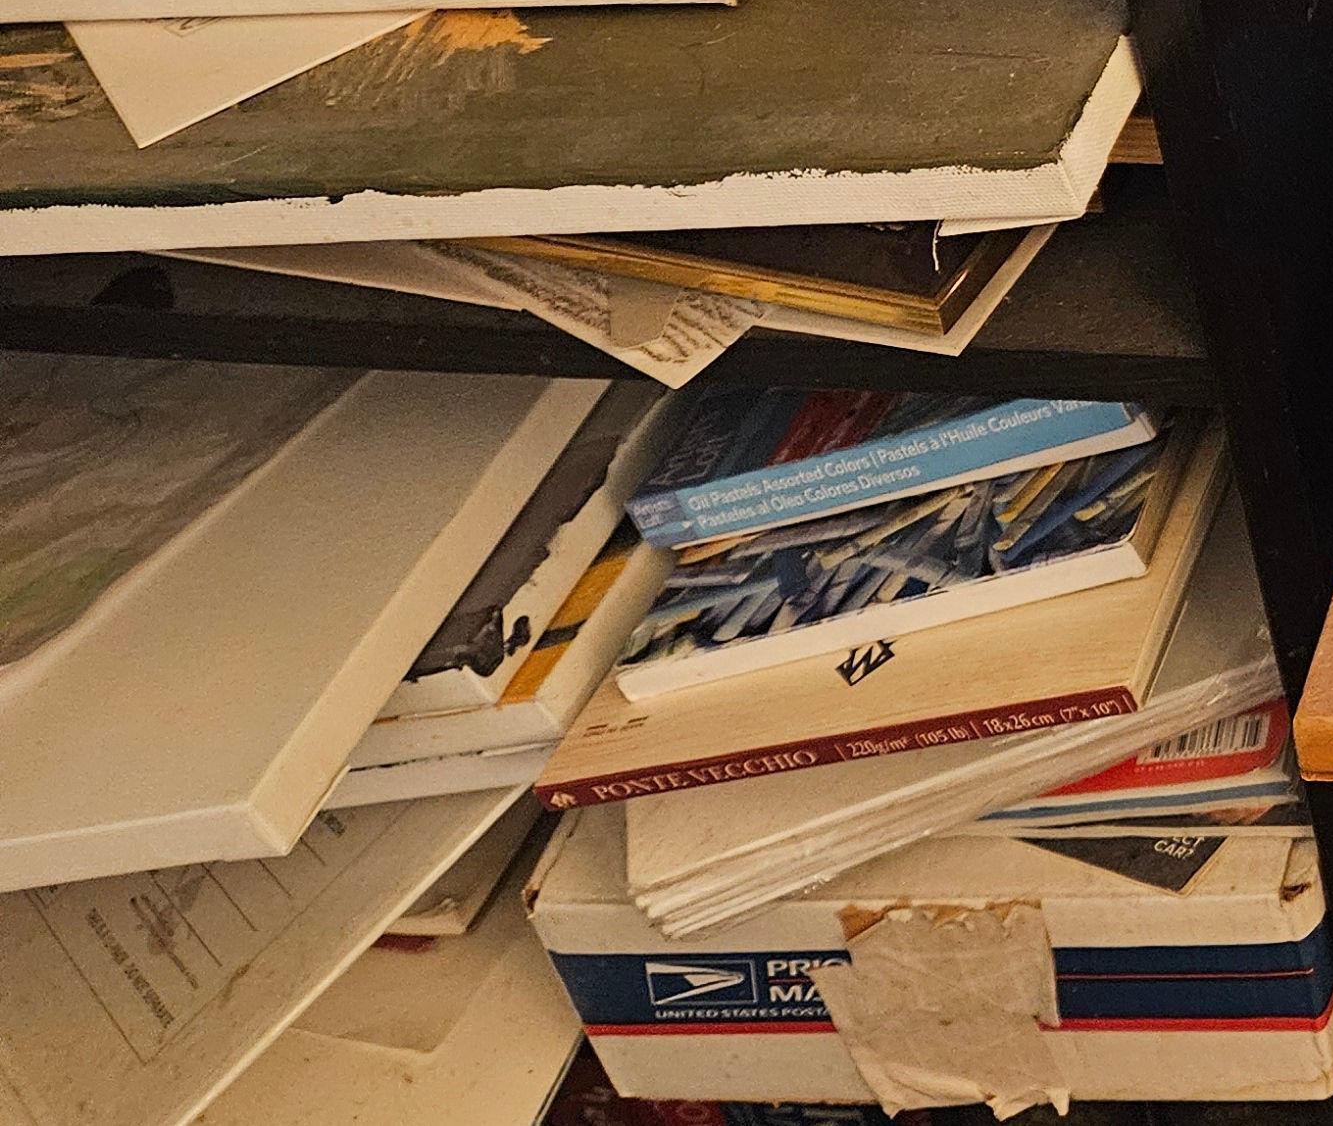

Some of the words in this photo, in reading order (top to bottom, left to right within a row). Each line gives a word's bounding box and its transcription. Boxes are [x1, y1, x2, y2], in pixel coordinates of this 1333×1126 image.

[688, 496, 708, 512] Oil
[710, 482, 762, 506] Pastels
[761, 466, 822, 494] Assorted
[823, 454, 872, 478] Colors
[879, 441, 928, 466] Pastels
[988, 405, 1052, 433] Couleurs
[696, 506, 752, 530] Pasteles
[752, 501, 770, 517] al
[804, 477, 859, 503] Colores
[858, 463, 921, 490] Diversos
[591, 771, 689, 802] PONTE
[687, 748, 819, 785] VECCHIO
[1153, 840, 1196, 860] CAR?
[769, 984, 824, 1004] MA
[655, 1008, 719, 1020] UNITED
[720, 1007, 778, 1019] STATES
